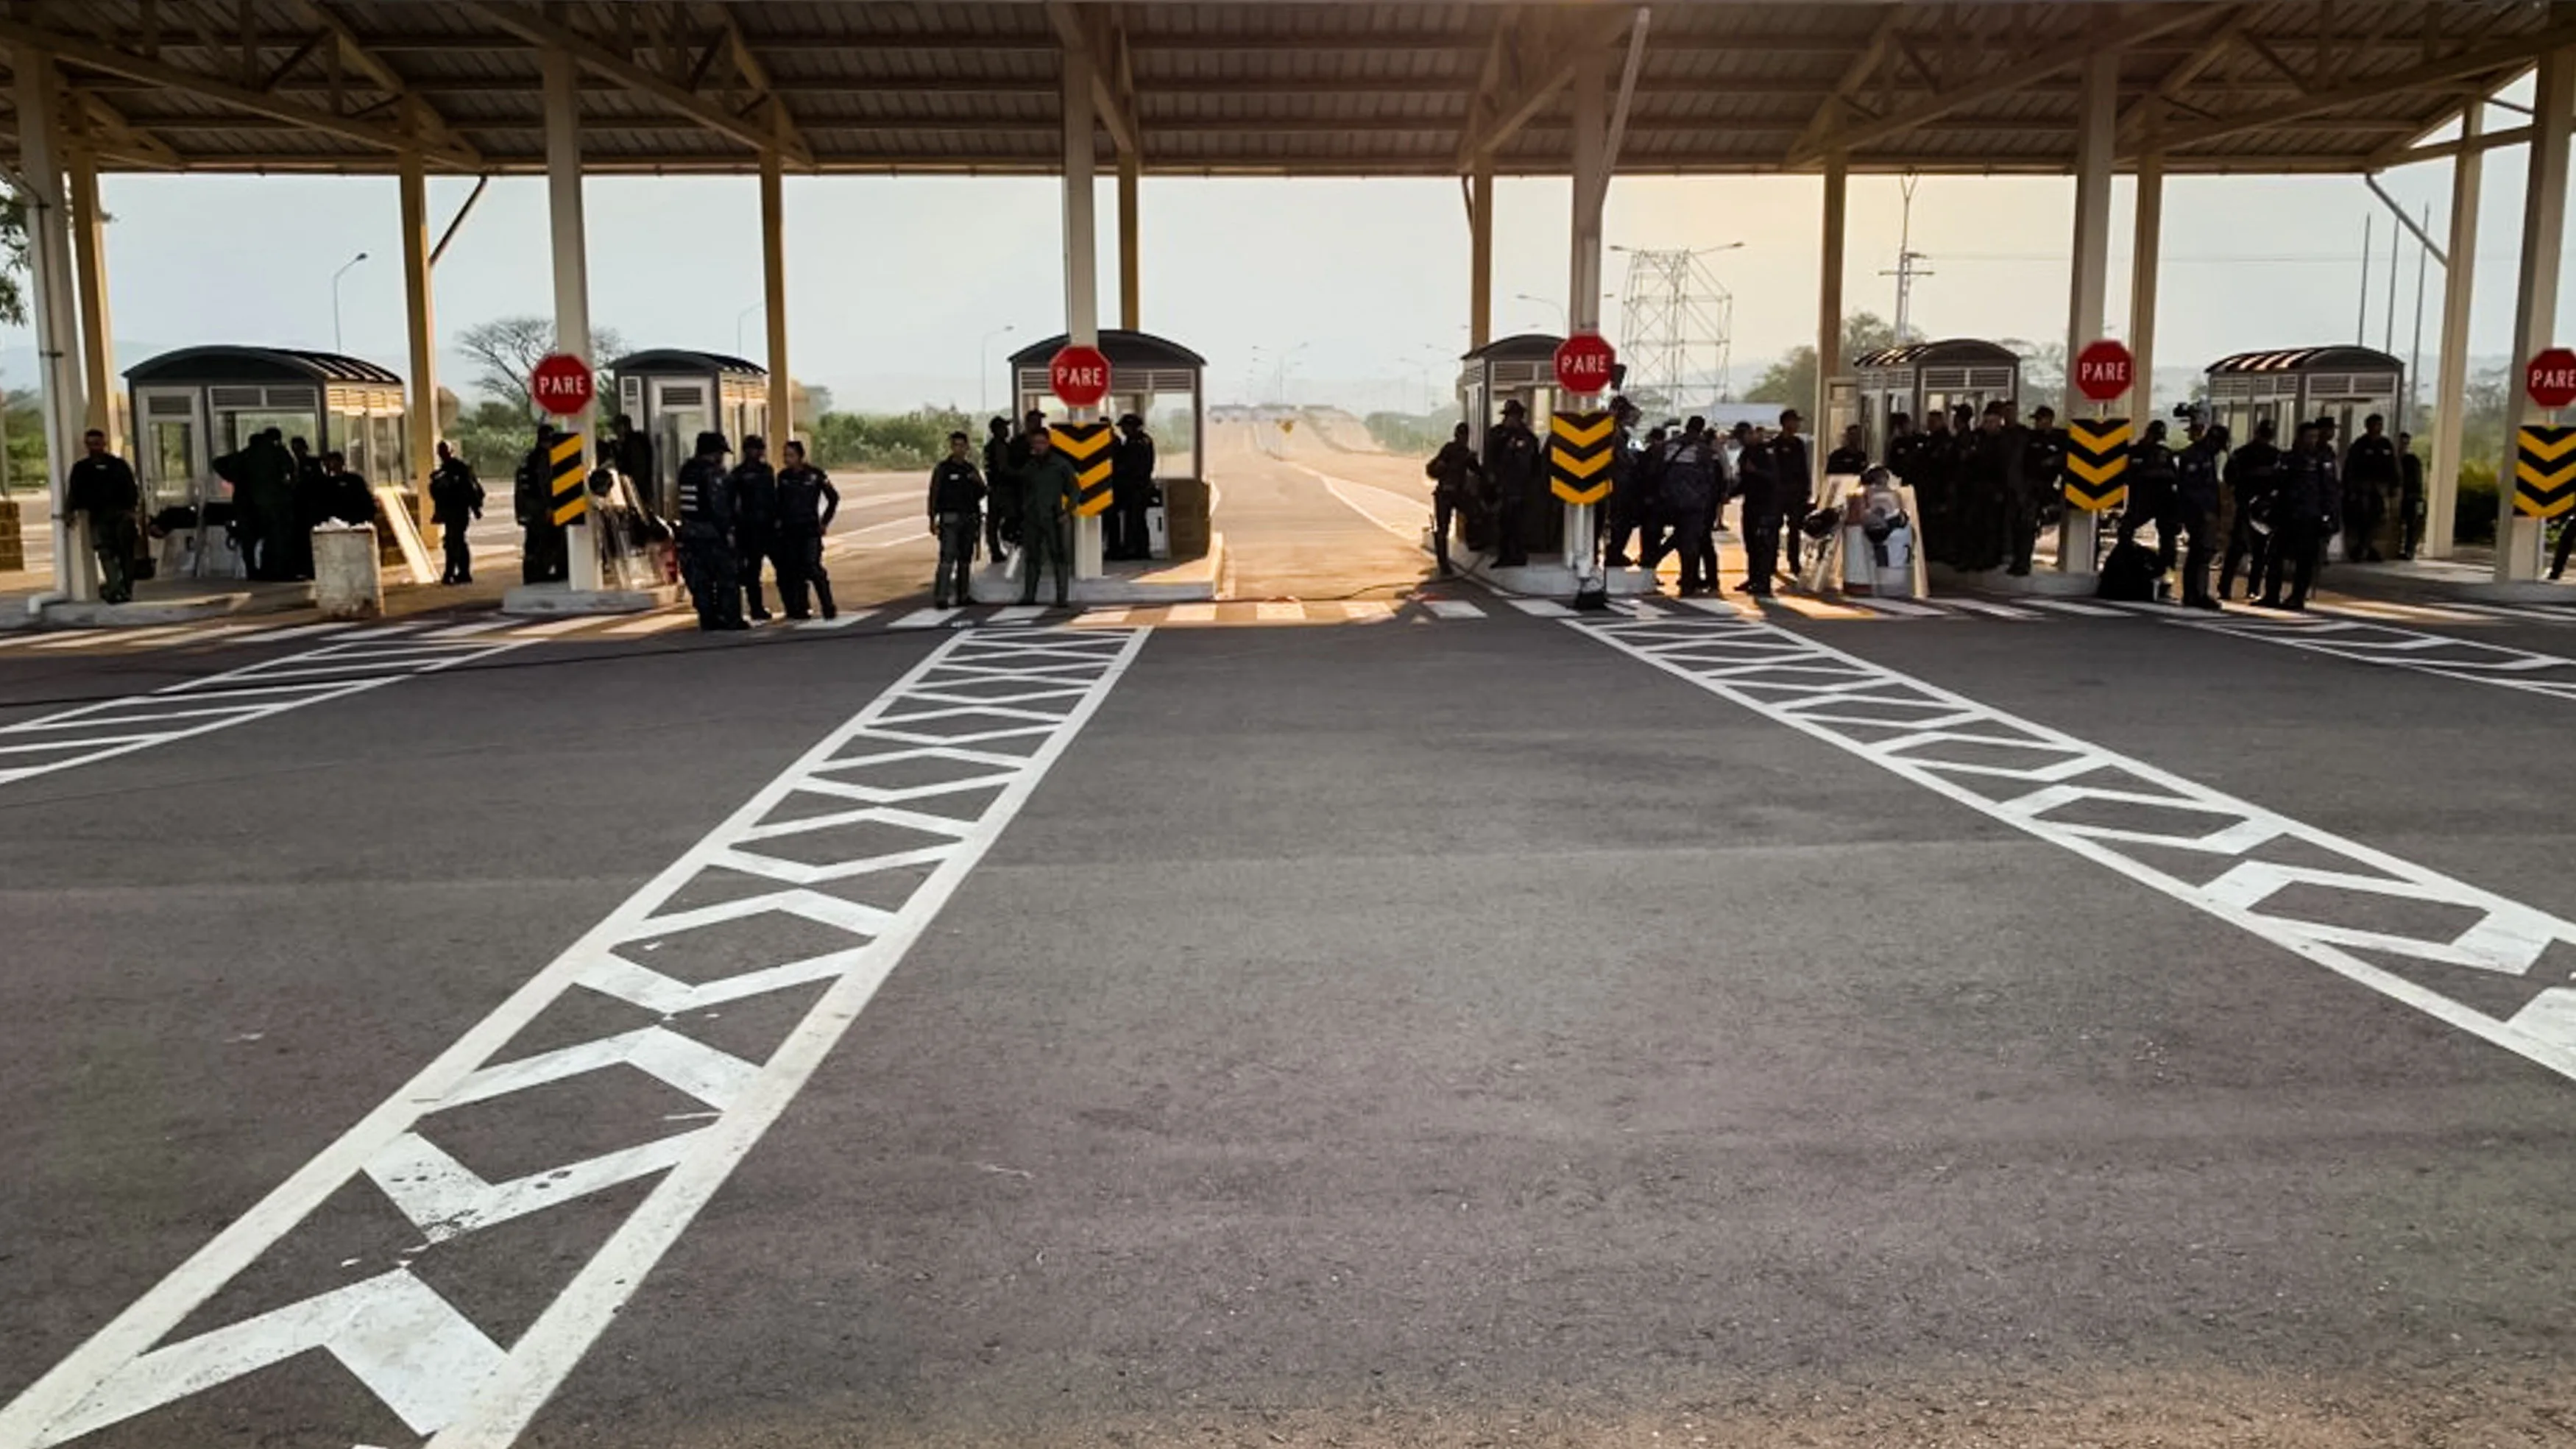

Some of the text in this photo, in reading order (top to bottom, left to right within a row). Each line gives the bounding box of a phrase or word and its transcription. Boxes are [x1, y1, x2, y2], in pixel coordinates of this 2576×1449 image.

[1560, 355, 1607, 374] PARE
[2081, 362, 2126, 380] PARE
[539, 376, 587, 395] PARE
[1056, 366, 1102, 386] PARE
[2532, 369, 2576, 388] PARE
